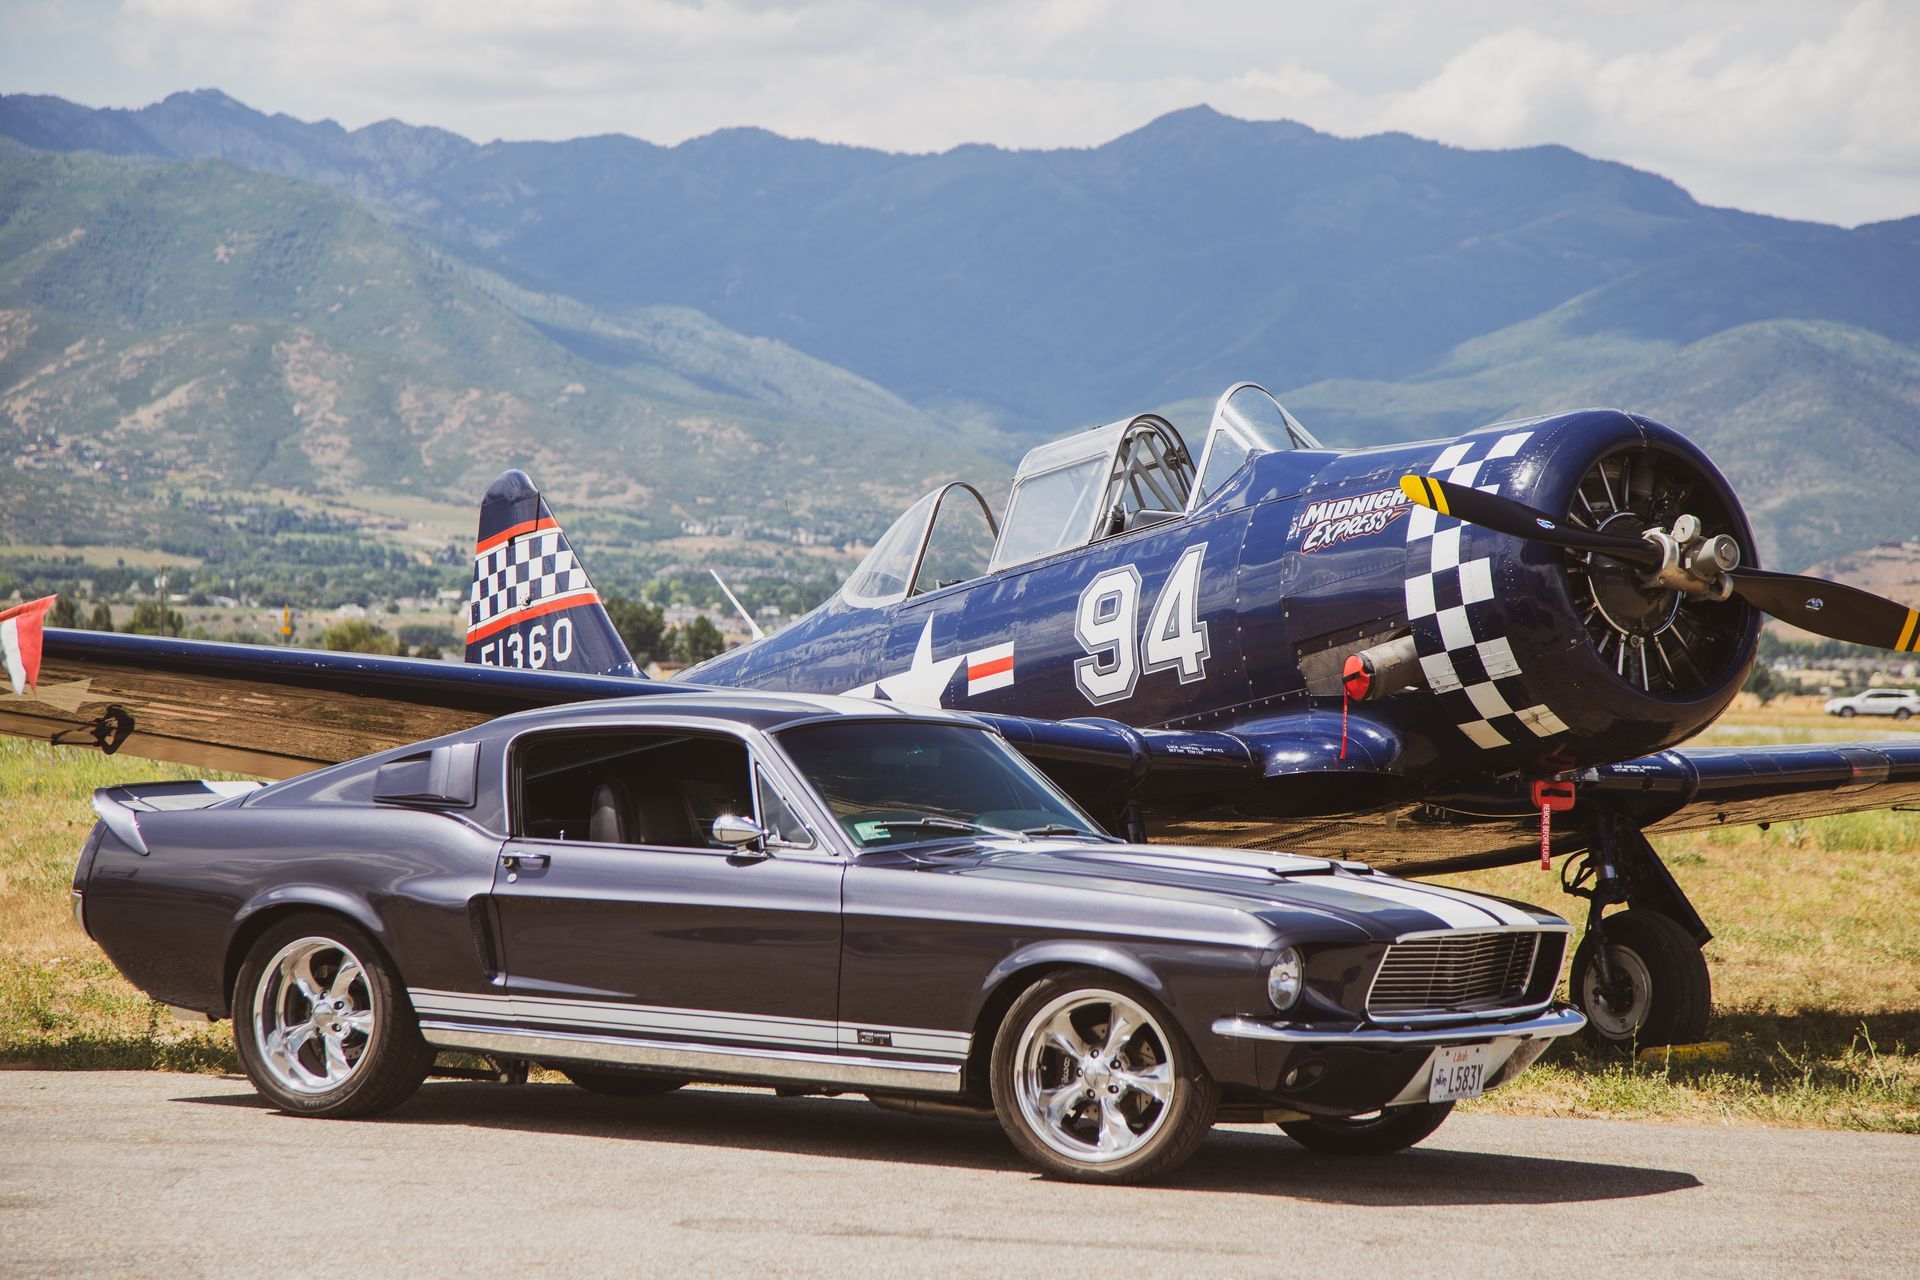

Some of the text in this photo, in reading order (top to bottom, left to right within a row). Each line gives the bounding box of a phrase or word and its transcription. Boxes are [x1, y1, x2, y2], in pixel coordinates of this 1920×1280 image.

[1301, 487, 1413, 528] MIDNIGH
[1302, 508, 1393, 553] EXPRESS
[1074, 542, 1211, 707] 94
[1448, 1063, 1484, 1093] L583Y
